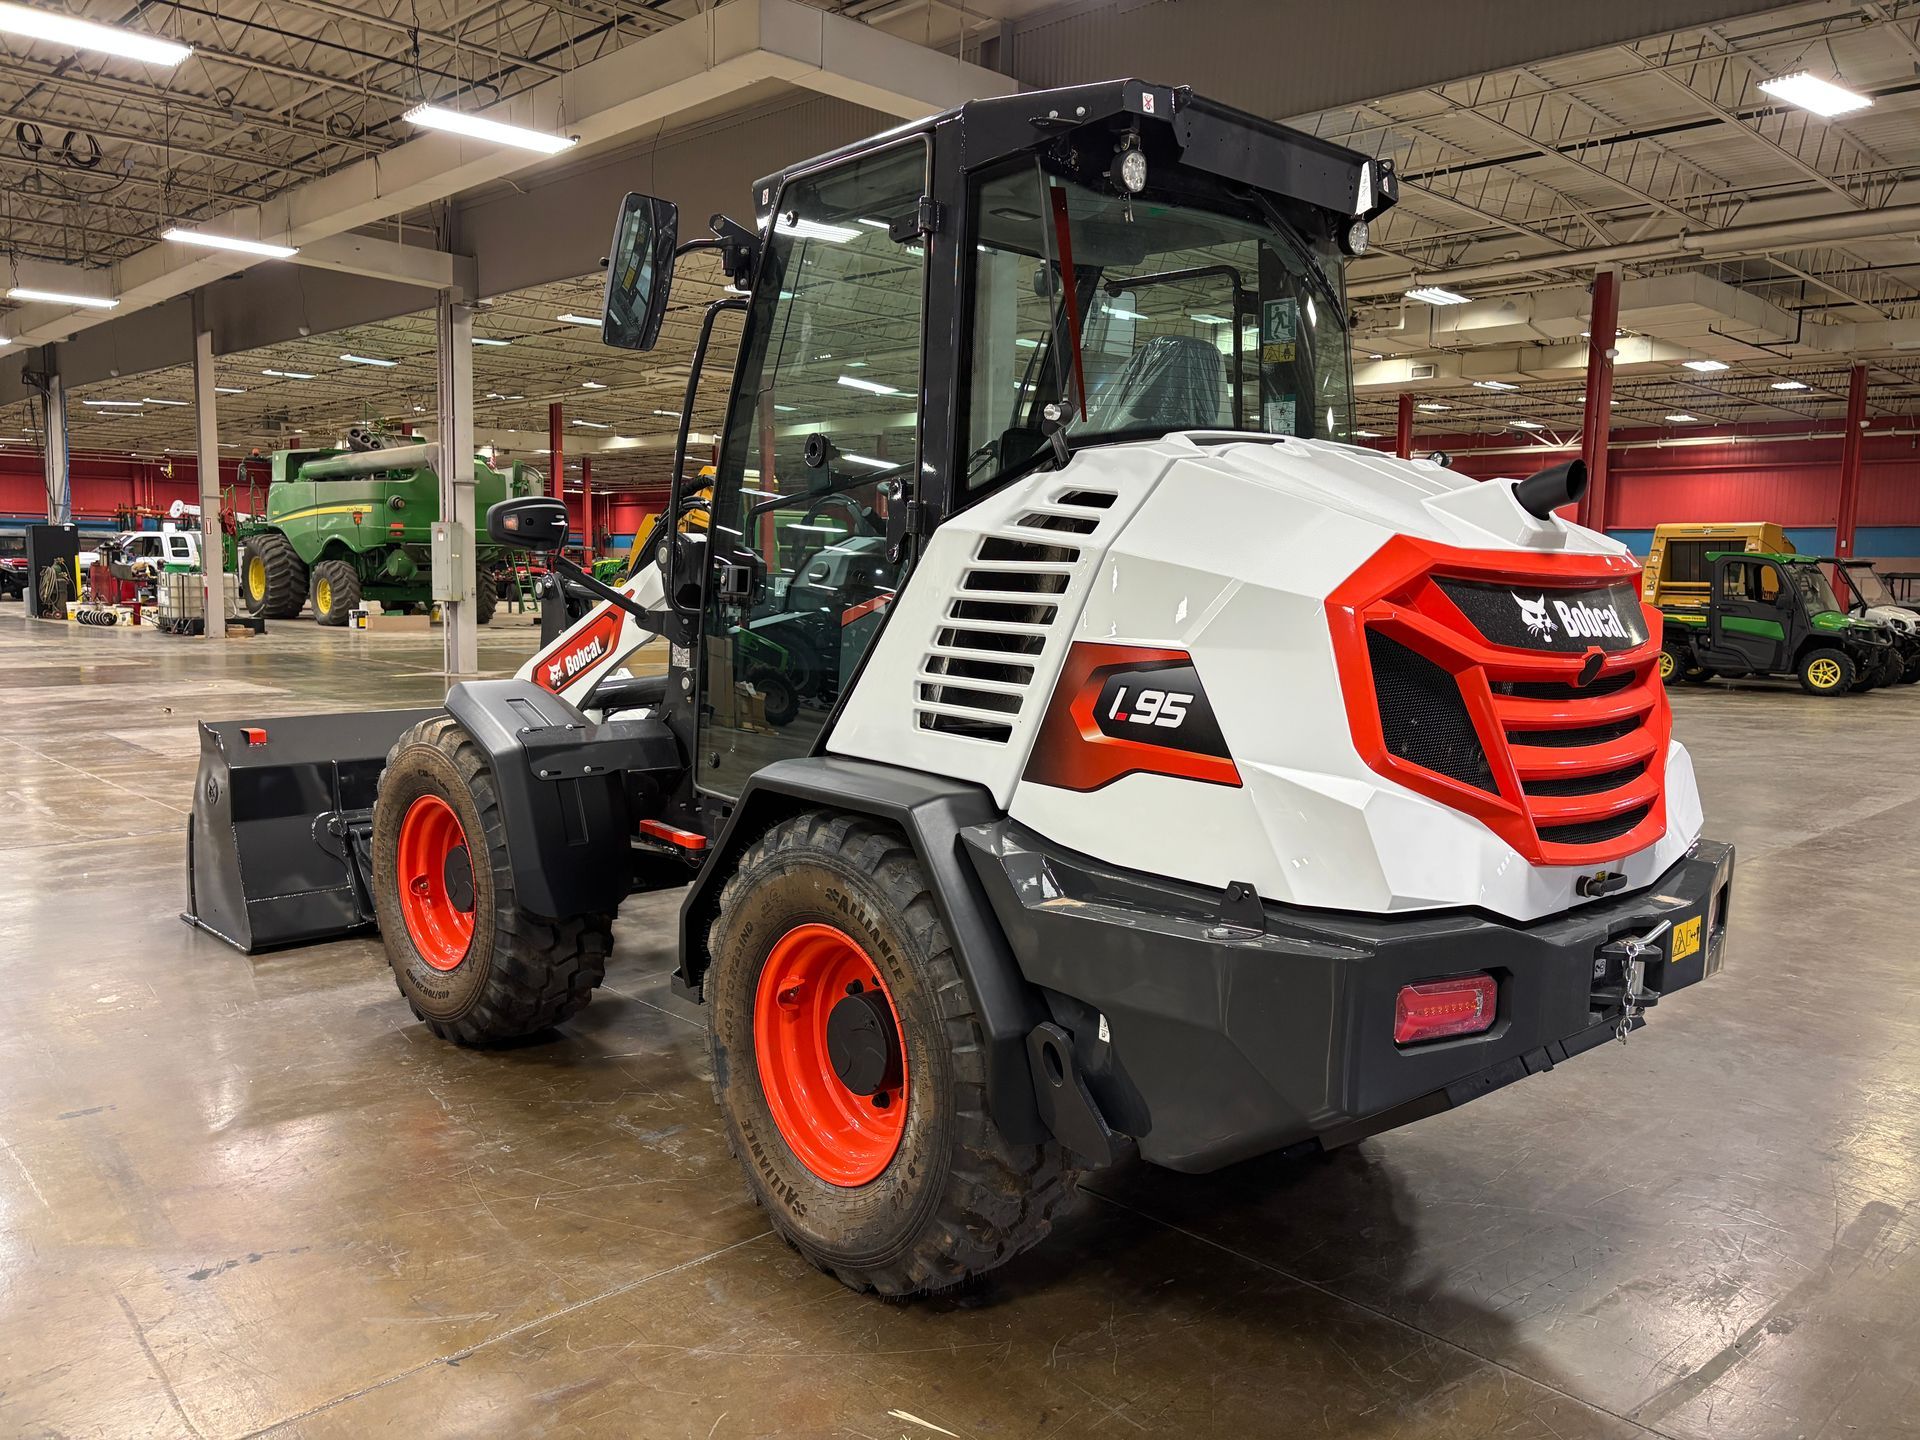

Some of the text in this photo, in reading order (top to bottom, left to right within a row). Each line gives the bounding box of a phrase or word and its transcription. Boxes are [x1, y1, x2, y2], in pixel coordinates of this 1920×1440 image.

[1552, 600, 1629, 638] Bobcat
[565, 635, 602, 677] Bobcat
[837, 894, 905, 983] ALLIANCE
[740, 1118, 800, 1208] ALLIANCE
